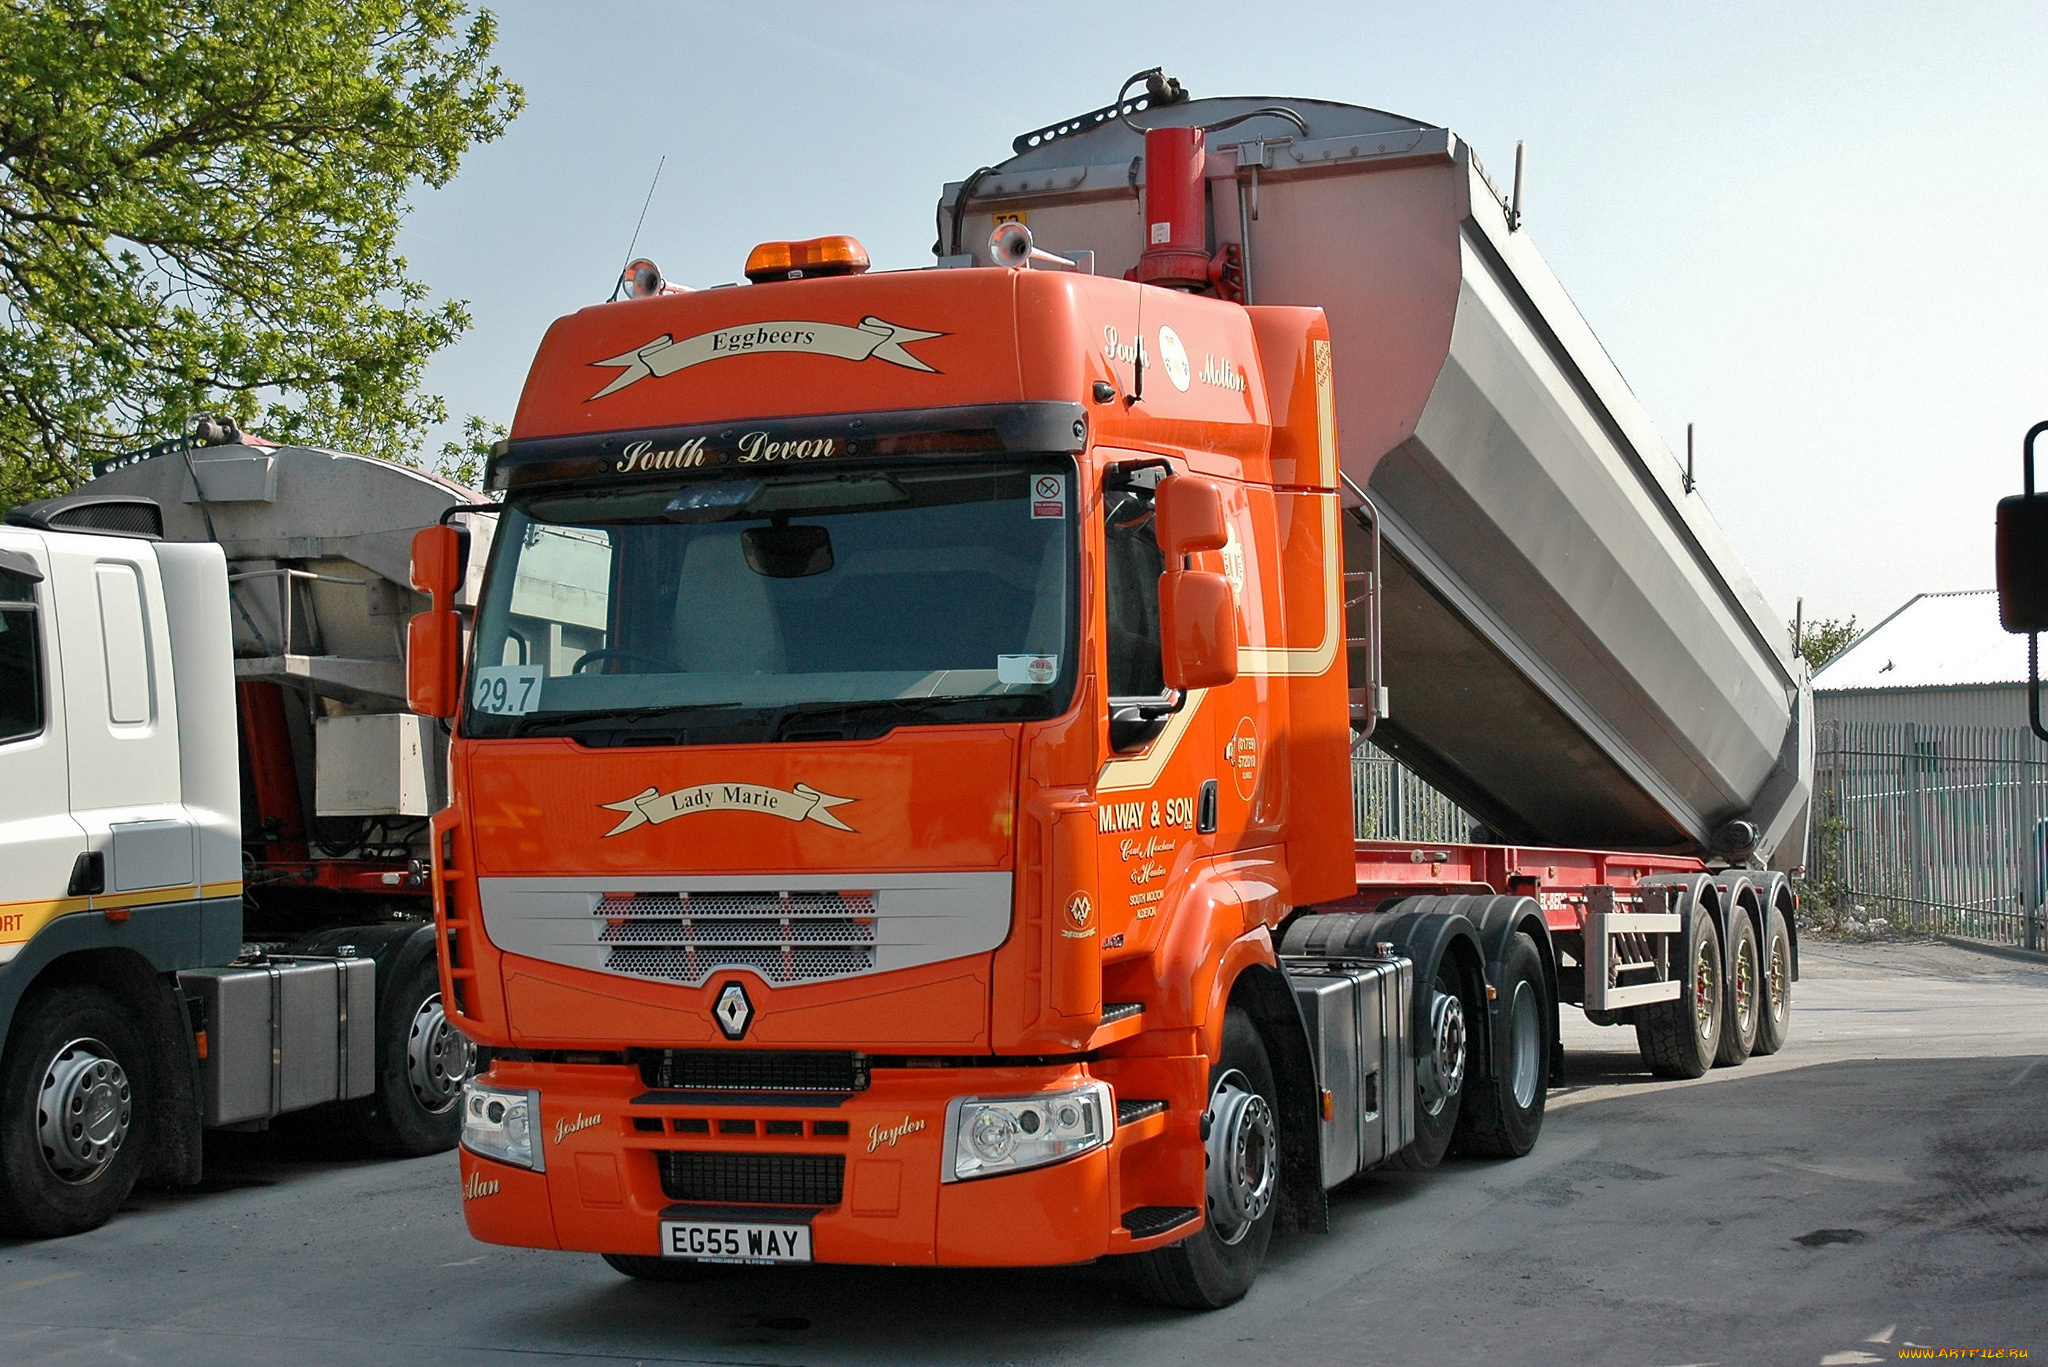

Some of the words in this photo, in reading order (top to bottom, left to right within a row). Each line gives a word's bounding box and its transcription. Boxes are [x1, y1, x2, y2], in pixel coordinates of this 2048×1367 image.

[712, 327, 815, 352] Eggbeers
[1199, 352, 1248, 392] Molton
[616, 436, 707, 473] South
[738, 431, 835, 463] Devon
[477, 677, 536, 713] 29.7
[671, 788, 714, 812] Lady
[722, 786, 778, 809] Marie
[1098, 801, 1145, 834] M.WAY
[1150, 800, 1161, 829] &
[1165, 797, 1193, 827] SON
[554, 1112, 602, 1145] Joshua
[867, 1115, 927, 1153] Jayden
[672, 1227, 739, 1255] EG55
[747, 1230, 798, 1257] WAY
